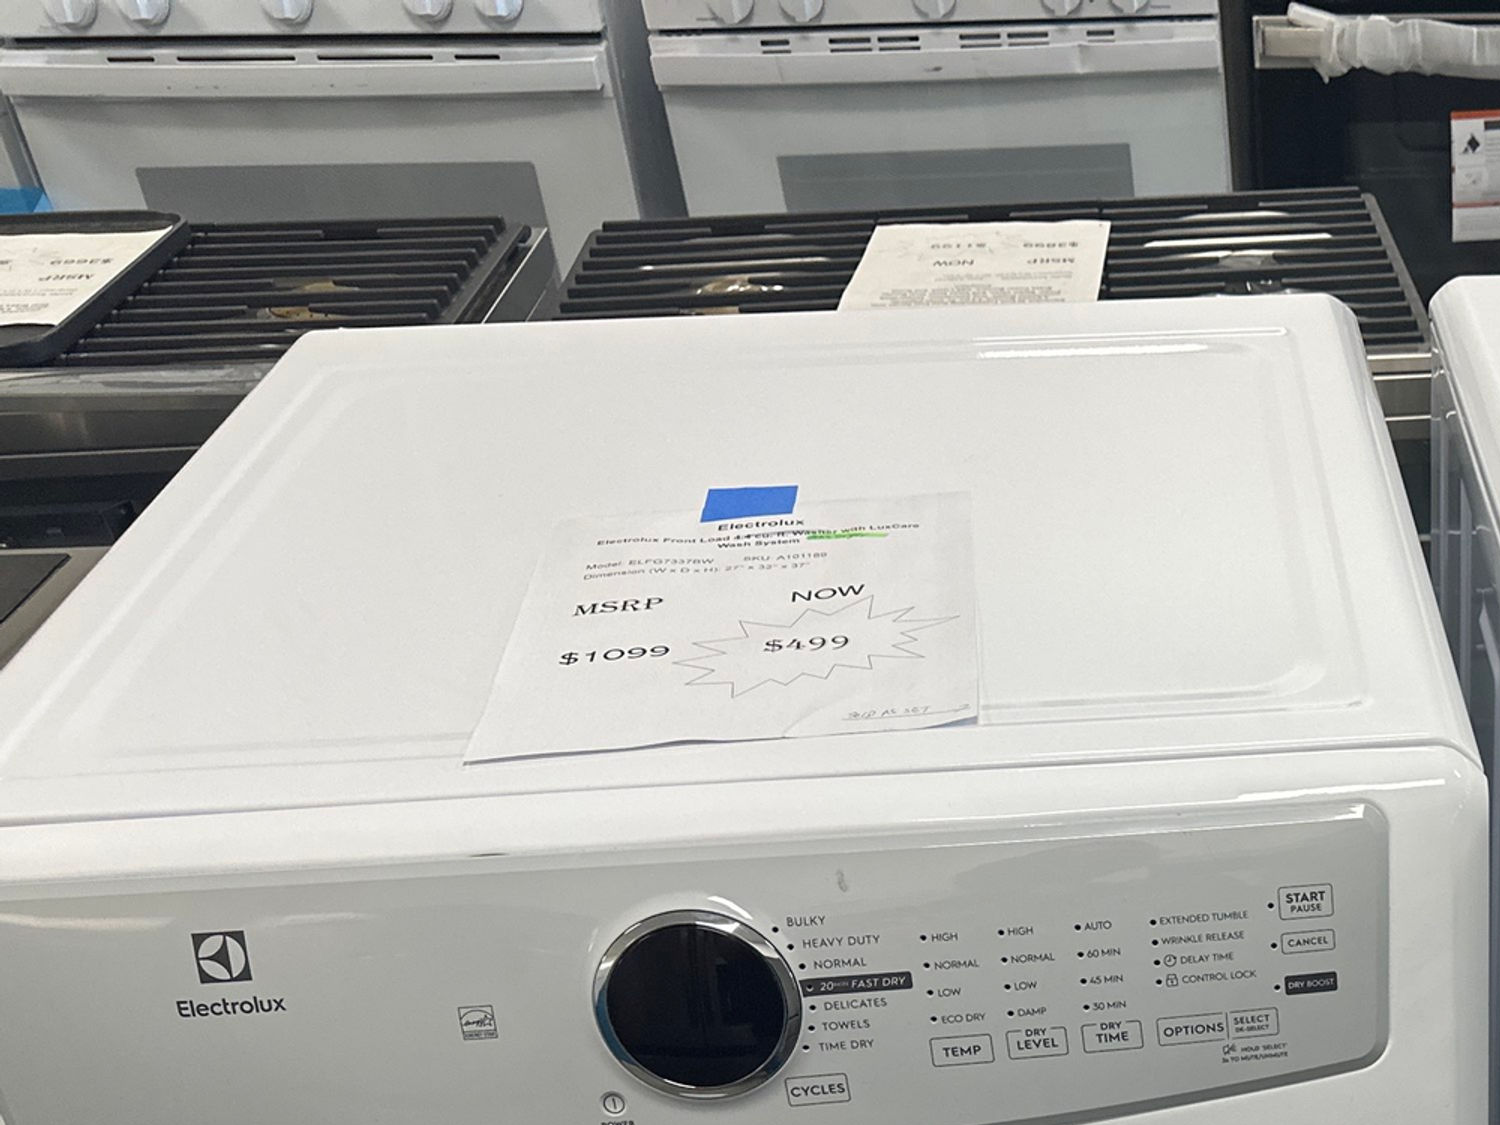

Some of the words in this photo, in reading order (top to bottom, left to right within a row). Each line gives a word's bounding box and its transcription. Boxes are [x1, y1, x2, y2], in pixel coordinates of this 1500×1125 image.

[717, 516, 805, 532] Electrolux
[596, 536, 658, 546] Electrolux
[662, 536, 696, 544] Front
[700, 534, 730, 544] Load
[840, 526, 866, 534] with
[869, 522, 920, 531] LuxCare
[754, 538, 800, 548] System
[572, 597, 664, 617] MSRP
[790, 583, 865, 603] NOW
[559, 644, 671, 667] $1099
[763, 634, 850, 654] $499
[1285, 890, 1326, 904] START
[1290, 903, 1322, 913] PAUSE
[786, 916, 826, 927] BULKY
[1160, 914, 1210, 926] EXTENDED
[1212, 910, 1249, 921] TUMBLE
[1007, 926, 1034, 937] HIGH
[1084, 920, 1113, 931] AUTO
[802, 936, 845, 950] HEAVY
[847, 934, 881, 946] DUTY
[931, 932, 959, 942] HIGH
[1161, 934, 1203, 945] WRINKLE
[1205, 931, 1245, 942] RELEASE
[1287, 937, 1328, 948] CANCEL
[1010, 952, 1055, 964] NORMAL
[1086, 949, 1099, 958] 60
[1100, 947, 1121, 956] MIN
[1180, 954, 1210, 965] DELAY
[1212, 952, 1234, 961] TIME
[813, 957, 867, 970] NORMAL
[934, 959, 980, 971] NORMAL
[851, 978, 879, 989] FAST
[882, 976, 906, 987] DRY
[1089, 976, 1102, 985] 45
[1104, 974, 1124, 983] MIN
[1182, 973, 1229, 984] CONTROL
[1231, 970, 1257, 980] LOCK
[1014, 980, 1038, 991] LOW
[1288, 980, 1305, 990] DRY
[1306, 978, 1334, 988] BOOST
[938, 988, 961, 997] LOW
[176, 996, 287, 1018] Electrolux
[823, 997, 888, 1011] DELICATES
[1092, 1002, 1105, 1011] 30
[1107, 1000, 1127, 1010] MIN
[1017, 1006, 1047, 1017] DAMP
[941, 1014, 964, 1024] ECO
[965, 1012, 986, 1022] DRY
[1233, 1014, 1270, 1025] SELECT
[822, 1019, 870, 1032] TOWELS
[1100, 1021, 1122, 1031] DRY
[1163, 1022, 1224, 1037] OPTIONS
[1025, 1028, 1047, 1038] DRY
[1096, 1030, 1130, 1044] TIME
[818, 1040, 847, 1051] TIME
[849, 1039, 874, 1050] DRY
[1017, 1037, 1059, 1050] LEVEL
[942, 1045, 982, 1058] TEMP
[790, 1082, 846, 1098] CYCLES
